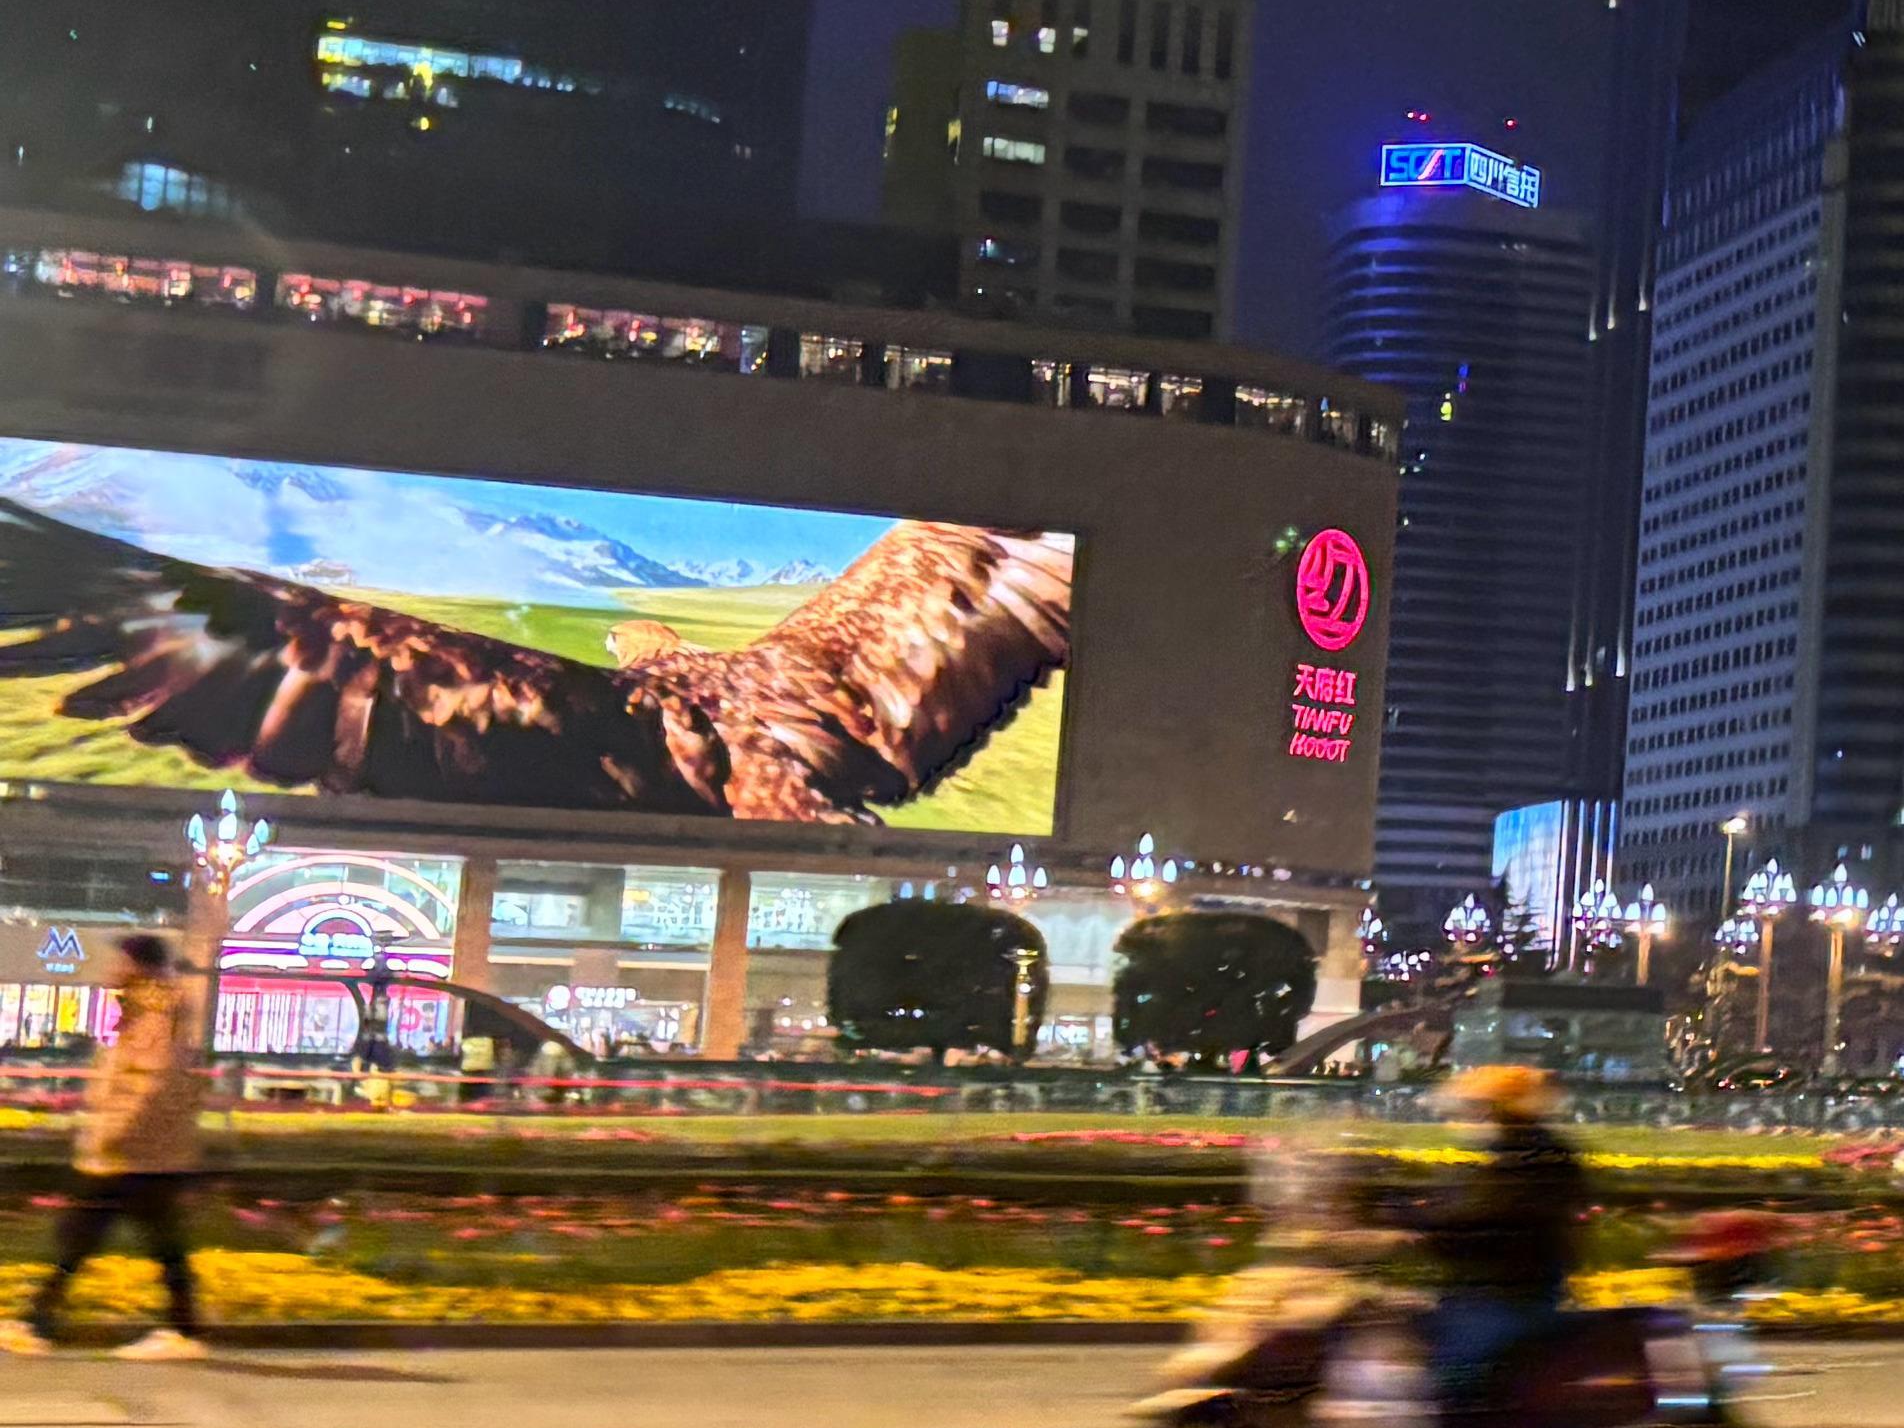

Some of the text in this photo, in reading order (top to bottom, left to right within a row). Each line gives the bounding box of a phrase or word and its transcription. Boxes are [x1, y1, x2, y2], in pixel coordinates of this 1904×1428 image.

[1293, 664, 1356, 704] 天府红
[1292, 705, 1353, 734] TIANFU
